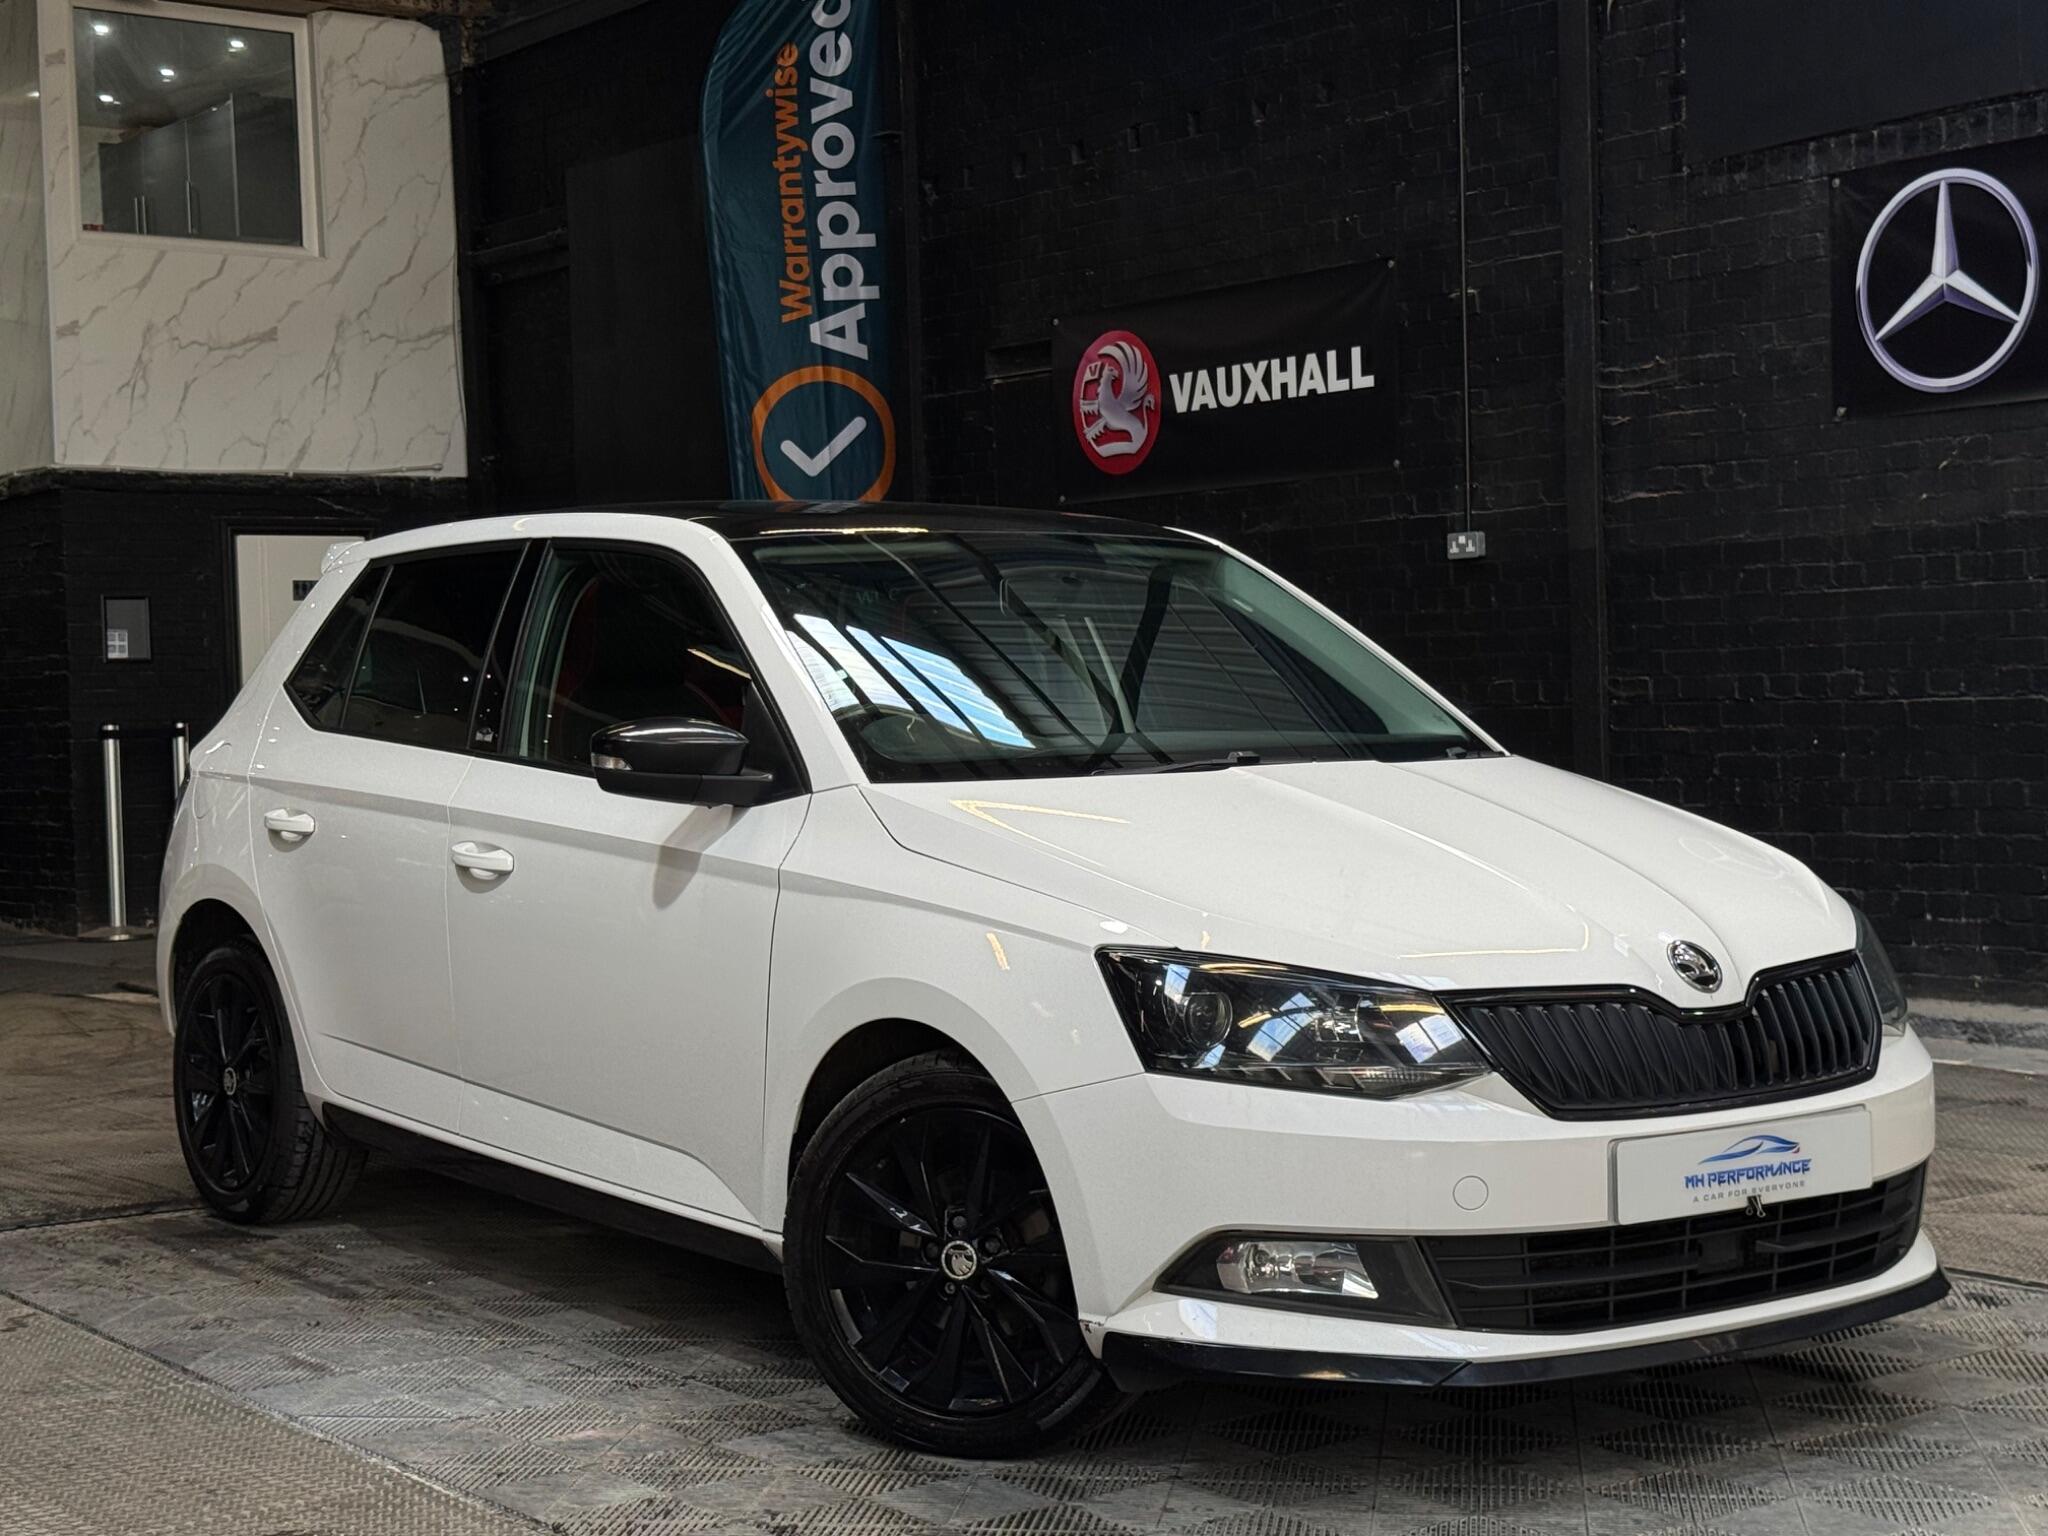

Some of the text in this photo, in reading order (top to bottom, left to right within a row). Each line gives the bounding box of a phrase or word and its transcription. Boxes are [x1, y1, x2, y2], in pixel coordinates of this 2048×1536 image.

[765, 40, 813, 324] Warrantywise
[1169, 346, 1375, 414] VAUXHALL
[1684, 1159, 1811, 1189] MH PERFORMANCE
[1703, 1191, 1724, 1201] CAR
[1728, 1189, 1748, 1197] FOR
[1751, 1180, 1806, 1194] EVERYONE
